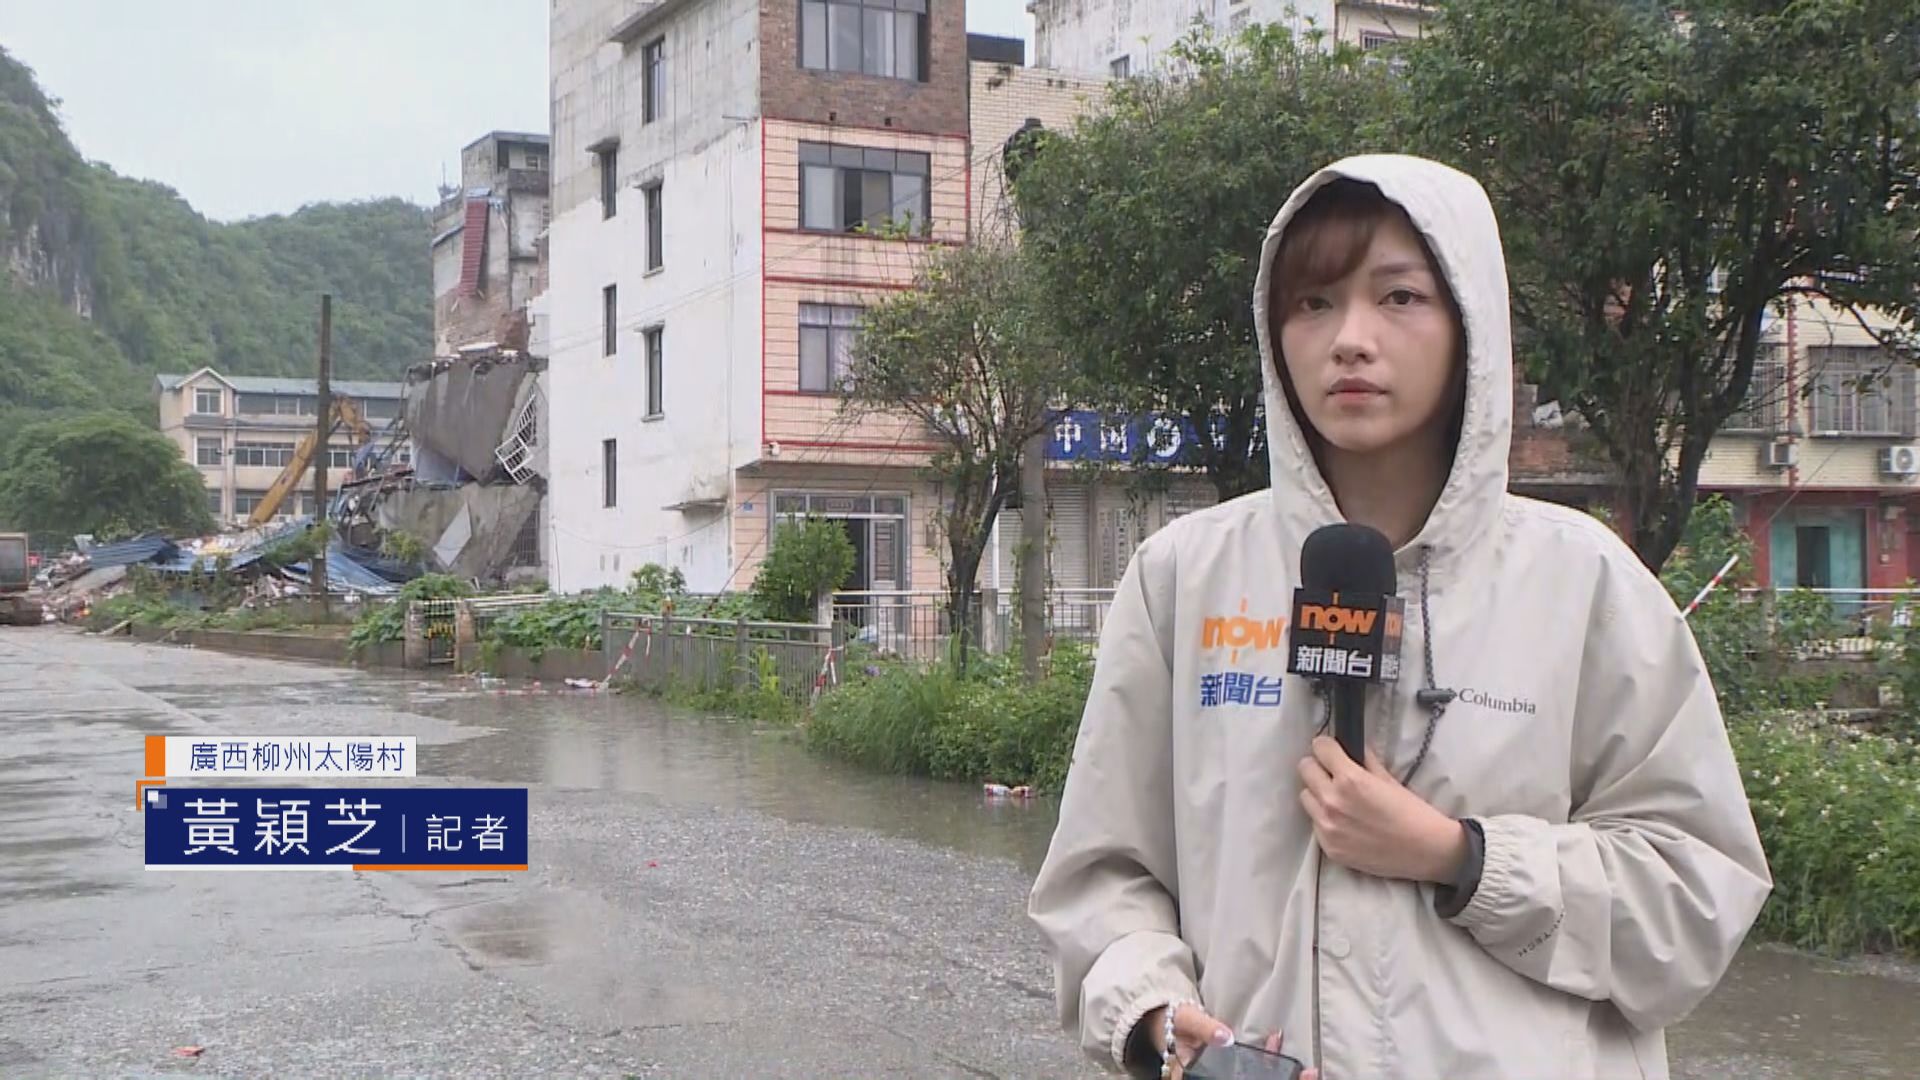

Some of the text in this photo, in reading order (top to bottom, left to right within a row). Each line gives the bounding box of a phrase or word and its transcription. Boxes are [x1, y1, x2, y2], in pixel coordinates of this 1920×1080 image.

[1203, 614, 1286, 651] now
[1299, 603, 1378, 635] now
[1296, 645, 1373, 677] 新聞台
[1200, 671, 1283, 708] 新聞台
[1459, 687, 1537, 715] Columbia
